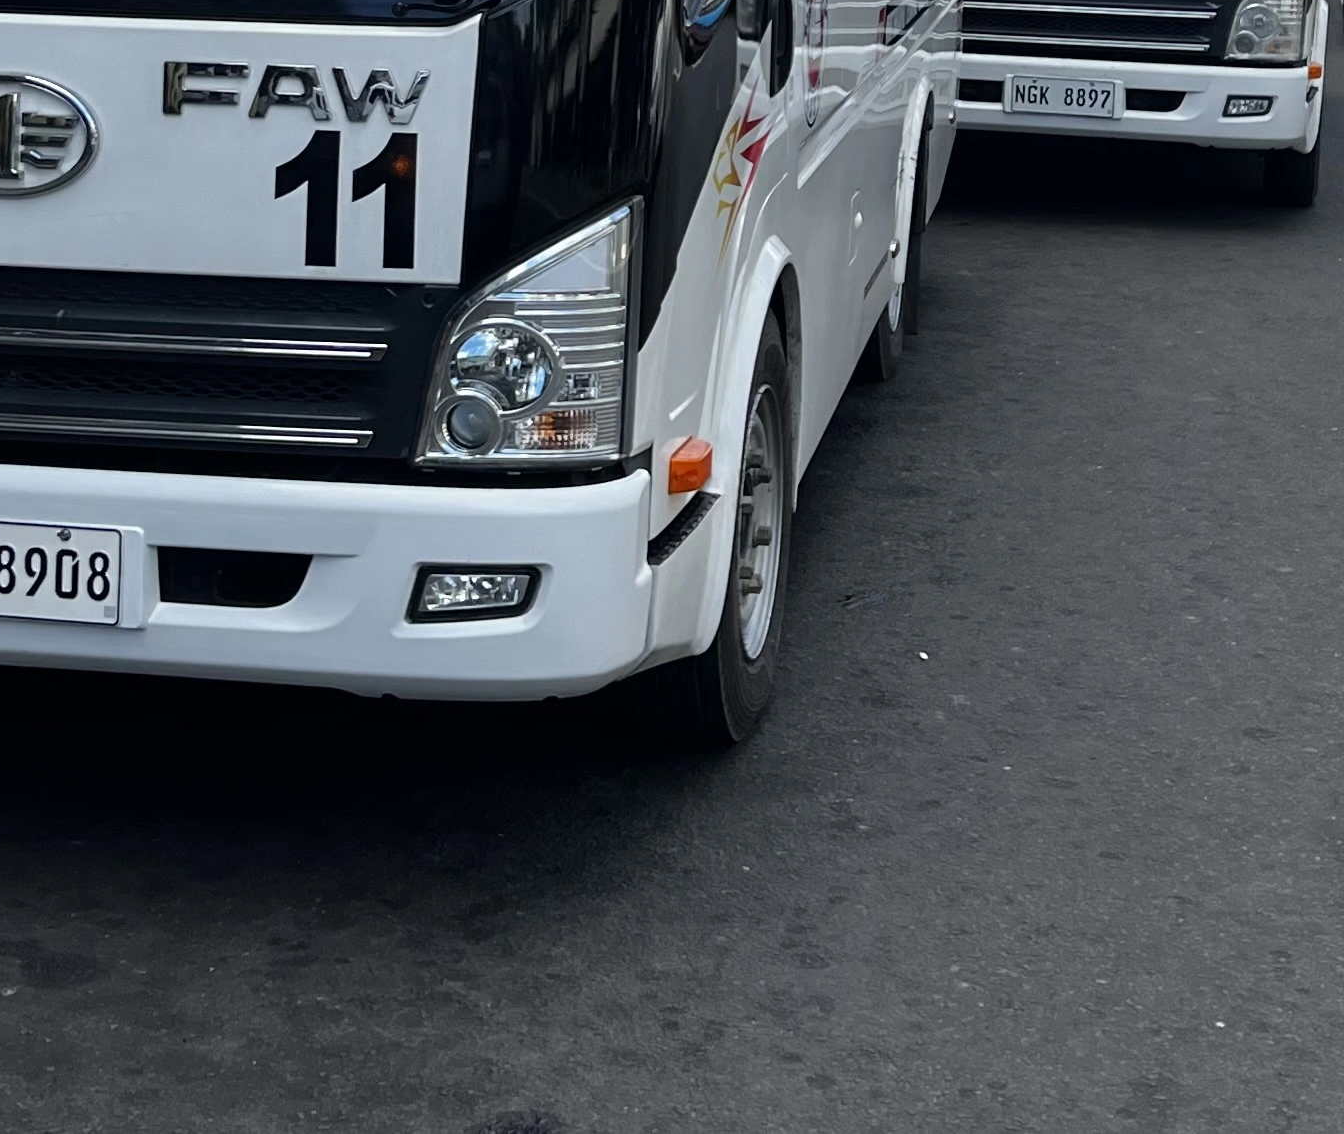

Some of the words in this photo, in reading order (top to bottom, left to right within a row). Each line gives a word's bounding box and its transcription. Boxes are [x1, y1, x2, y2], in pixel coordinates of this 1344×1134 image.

[162, 61, 431, 125] FAW
[1014, 84, 1050, 106] NGK
[1063, 86, 1112, 109] 8897
[274, 128, 419, 271] 11
